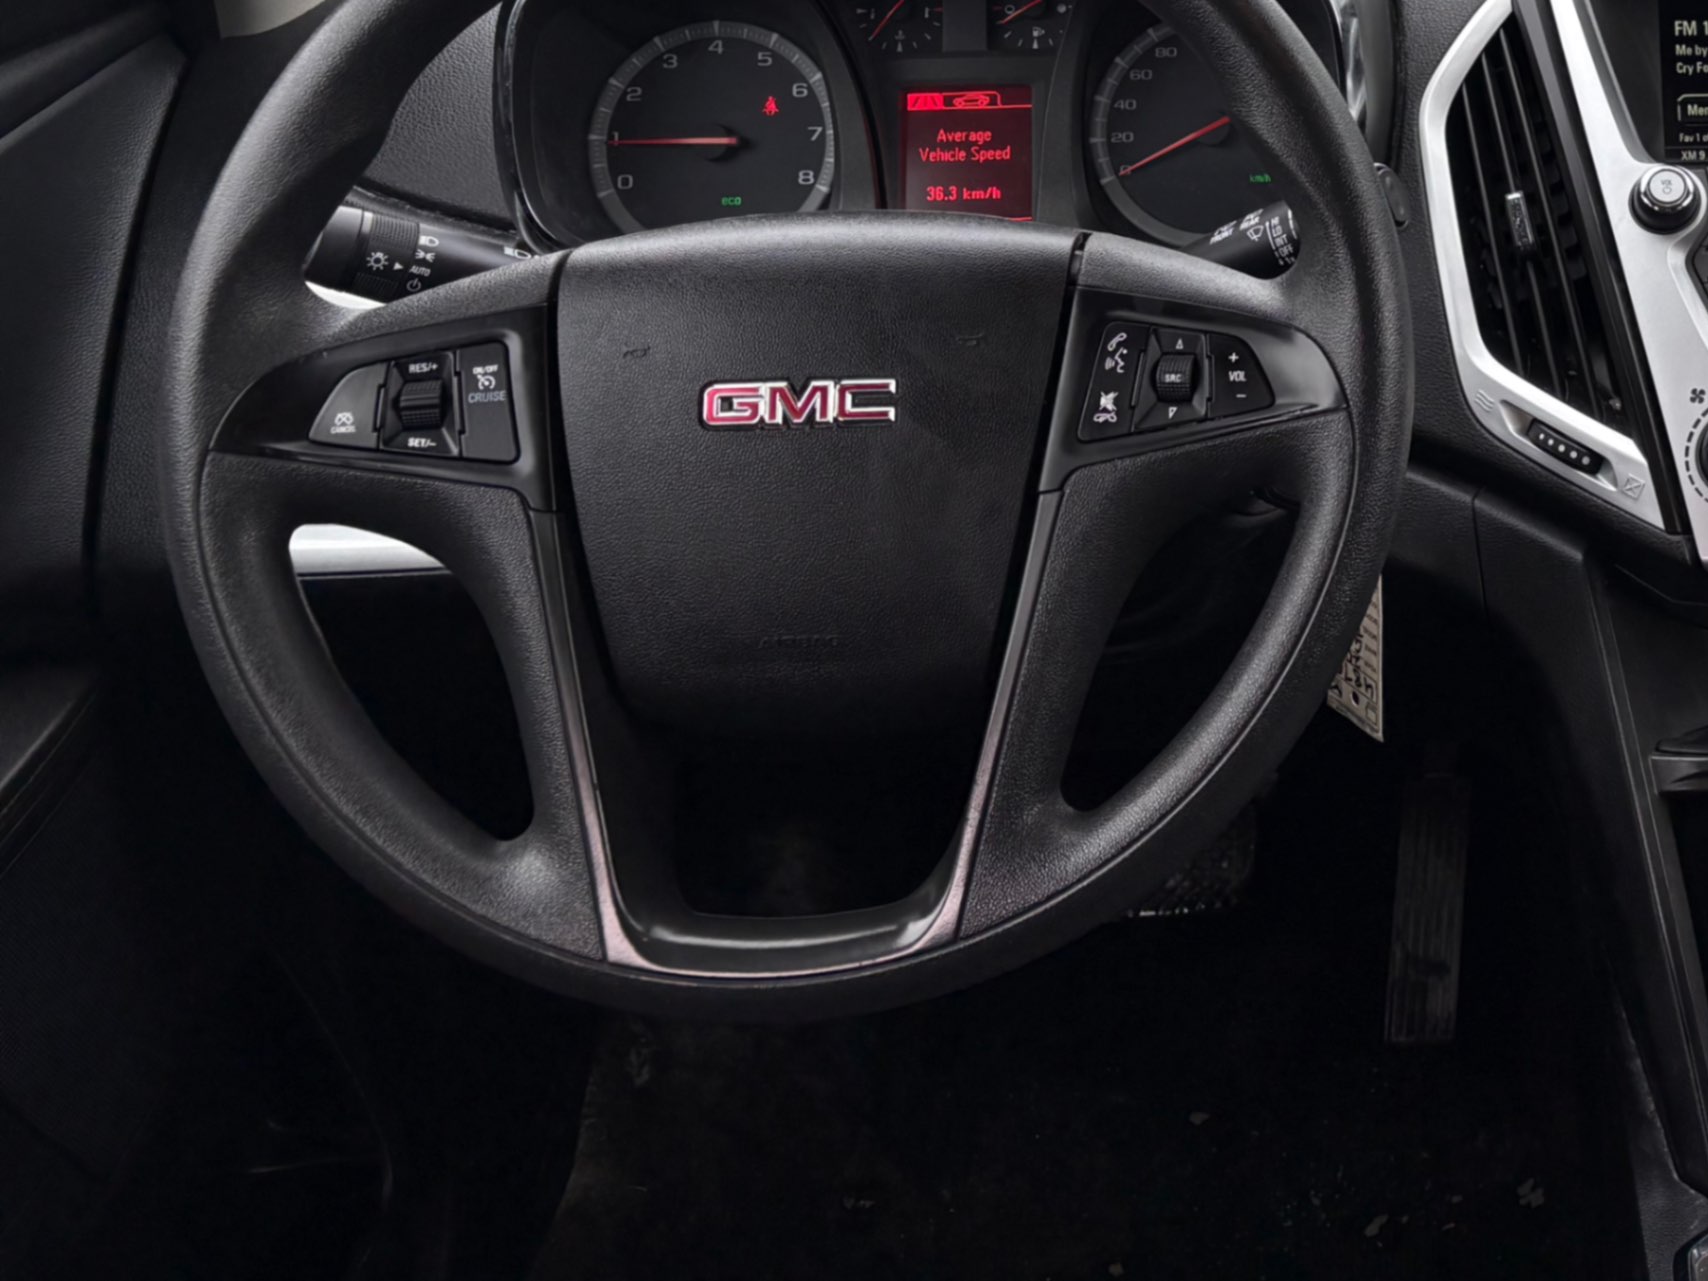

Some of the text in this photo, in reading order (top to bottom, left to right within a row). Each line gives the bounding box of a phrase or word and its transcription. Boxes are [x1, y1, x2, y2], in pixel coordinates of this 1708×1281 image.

[1674, 20, 1697, 36] FM
[708, 40, 724, 55] 4
[1155, 47, 1178, 58] 80
[1675, 44, 1708, 58] Me by
[662, 54, 678, 69] 3
[757, 51, 773, 66] 5
[1129, 69, 1153, 81] 60
[1676, 61, 1693, 75] Cry
[626, 86, 642, 102] 2
[791, 82, 809, 98] 6
[1113, 98, 1137, 111] 40
[612, 131, 620, 146] 1
[807, 126, 823, 141] 7
[936, 128, 992, 145] Average
[1110, 131, 1134, 143] 20
[1679, 132, 1694, 142] Fav
[919, 145, 1011, 163] Vehicle Speed
[1681, 150, 1706, 161] XM 9
[617, 174, 634, 190] 0
[797, 170, 815, 185] 8
[1249, 173, 1271, 183] km/h
[926, 186, 1002, 201] 36.3 km/h
[721, 196, 742, 207] eco
[409, 265, 431, 277] AUTO
[1164, 374, 1183, 383] SRC
[1228, 370, 1247, 382] VOL
[468, 390, 507, 403] CRUISE
[703, 379, 896, 426] GMC
